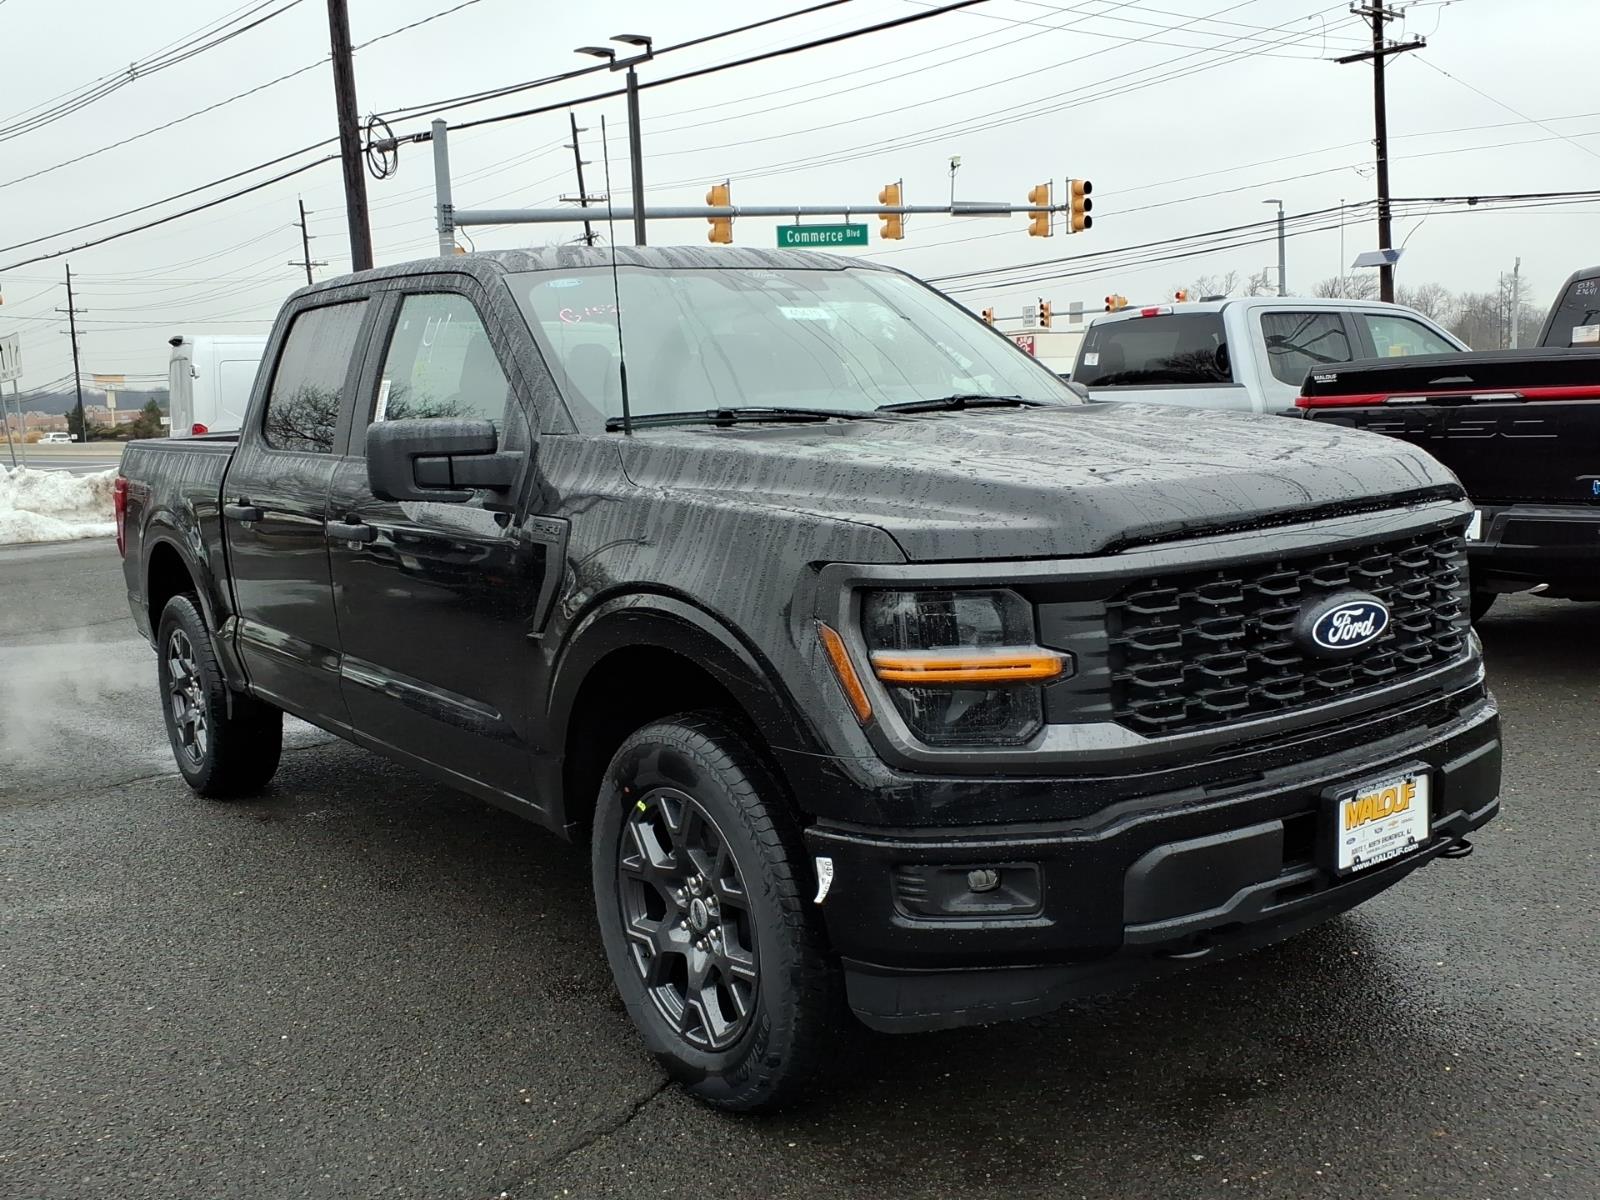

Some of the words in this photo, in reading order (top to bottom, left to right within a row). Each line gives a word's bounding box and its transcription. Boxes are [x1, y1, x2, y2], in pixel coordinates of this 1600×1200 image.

[786, 230, 843, 243] Commerce
[846, 229, 860, 238] Blvd
[1328, 607, 1375, 643] Ford
[1345, 782, 1416, 831] MALOUF
